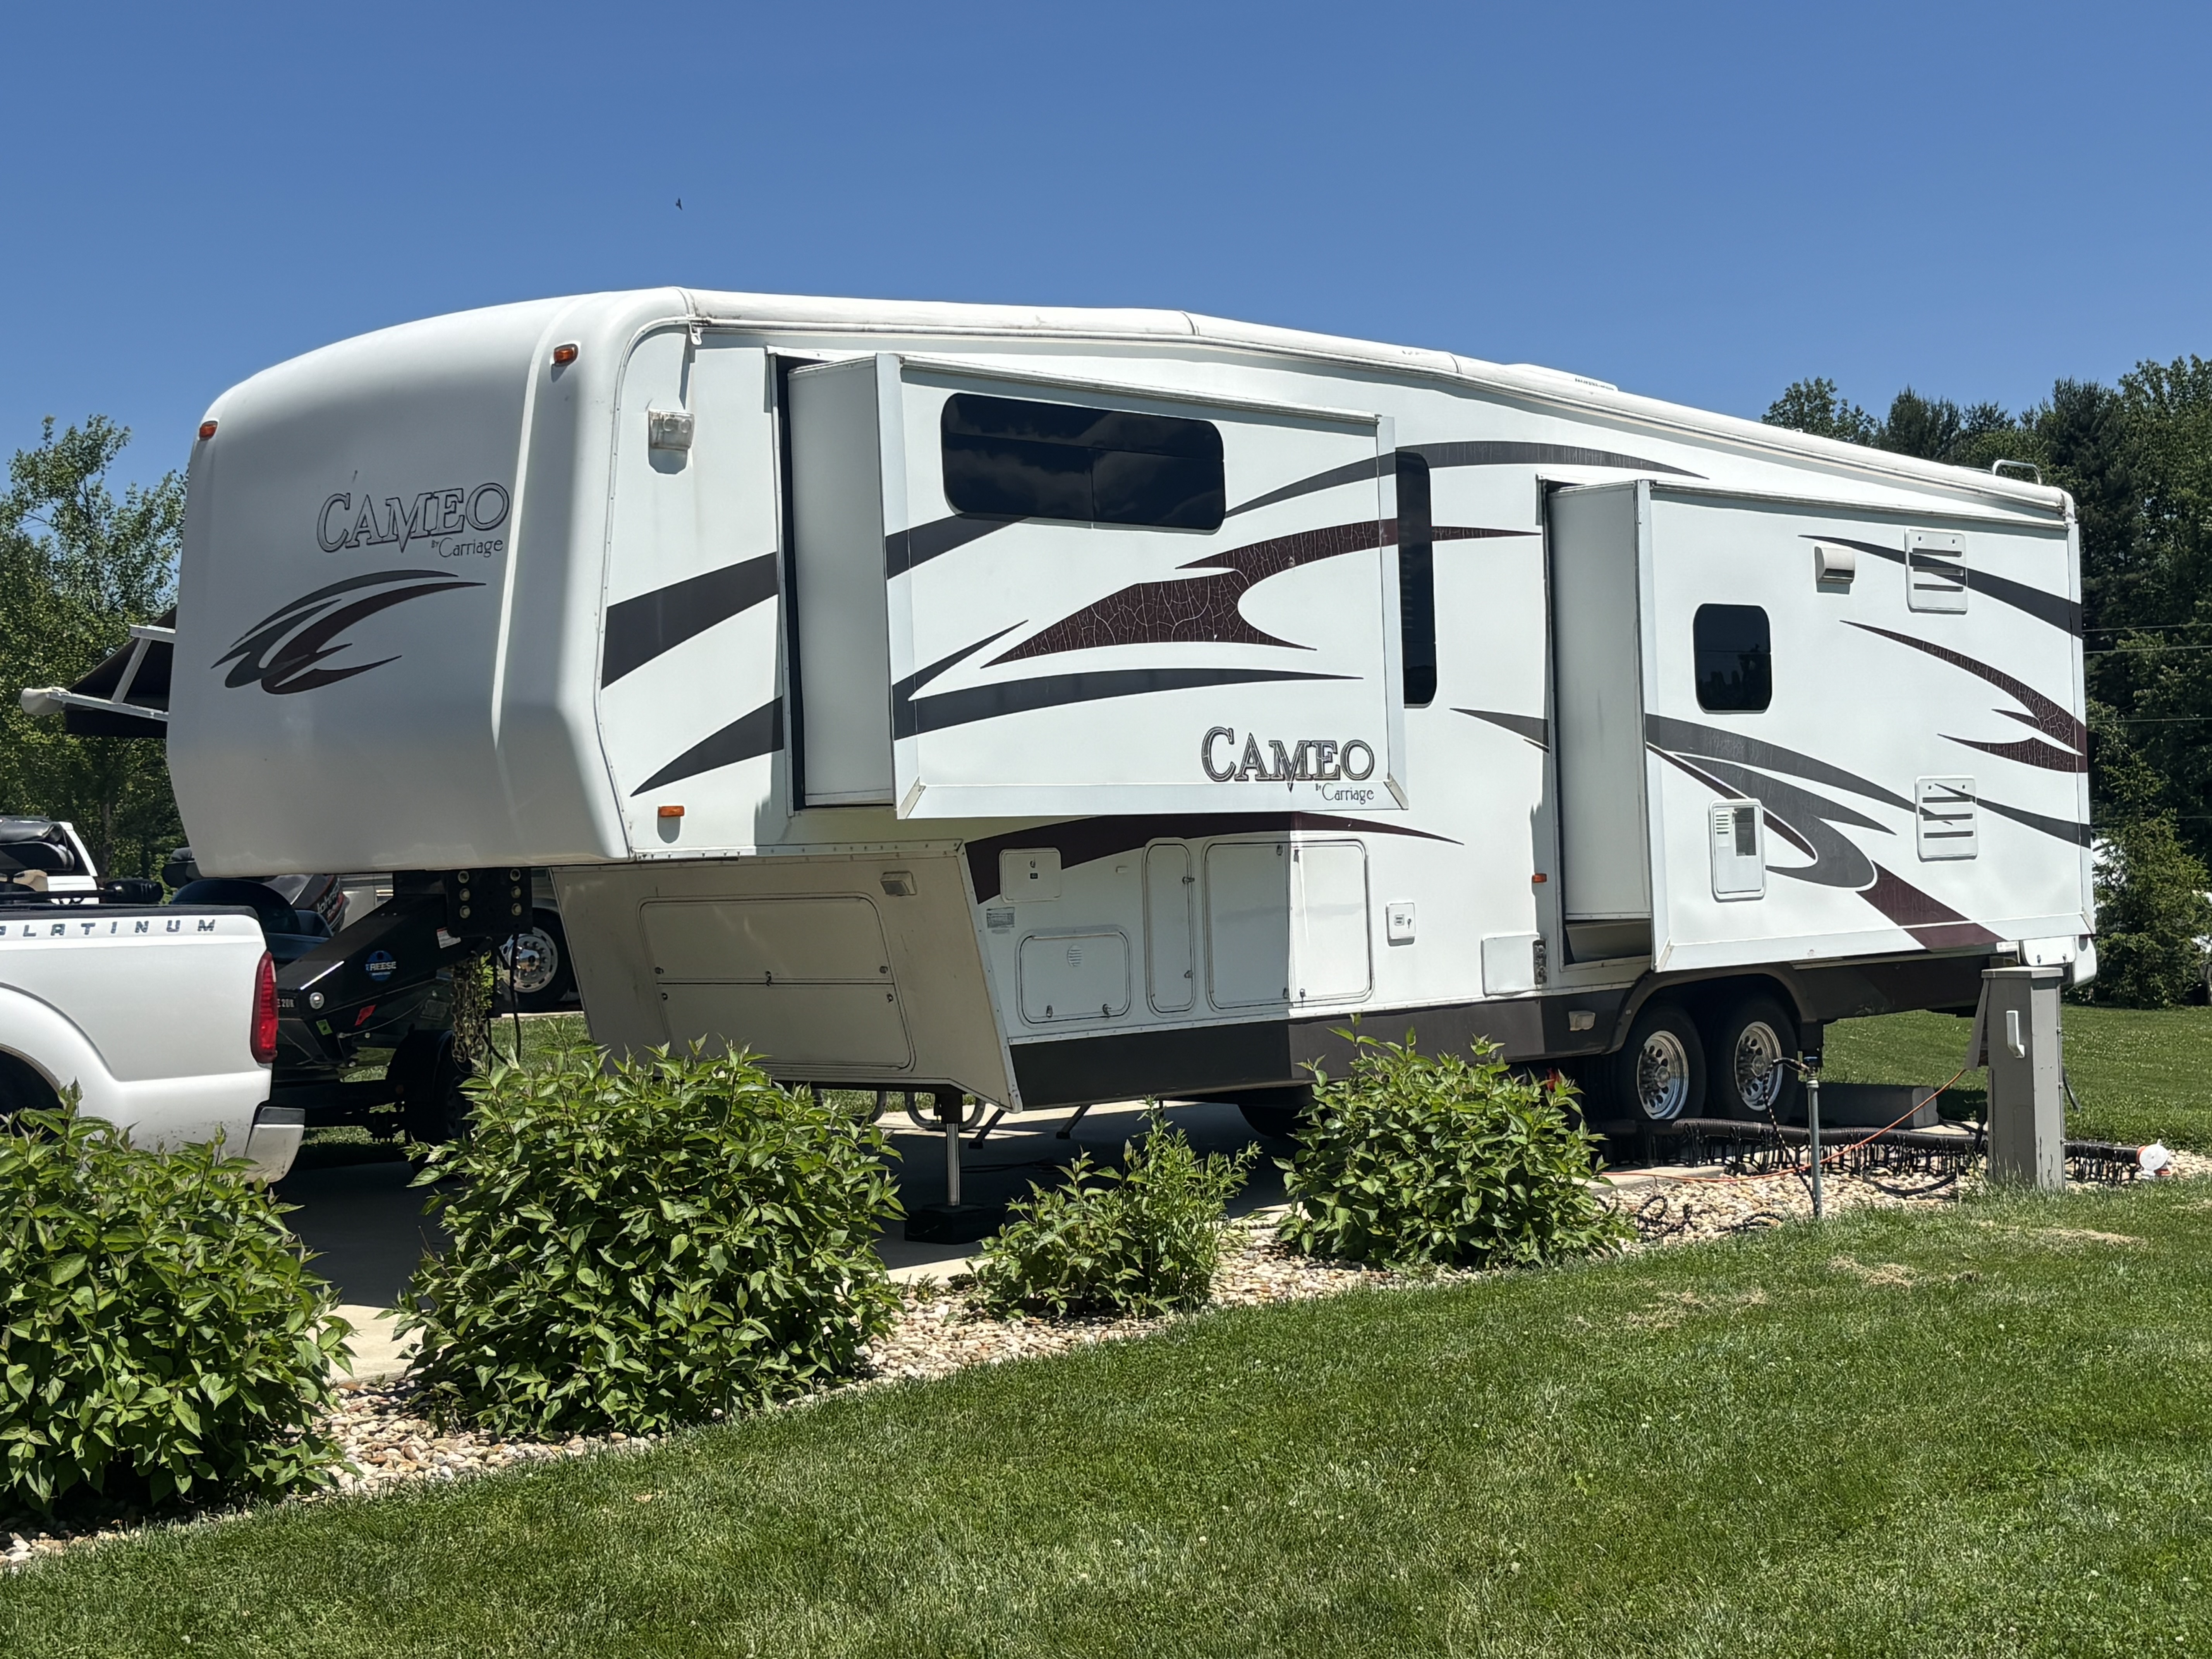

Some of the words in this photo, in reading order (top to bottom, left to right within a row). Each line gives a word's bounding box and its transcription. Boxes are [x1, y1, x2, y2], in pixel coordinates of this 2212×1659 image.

[317, 483, 510, 553] CAMEO
[439, 537, 503, 558] Carriage
[1201, 726, 1374, 793] CAMEO
[1322, 783, 1374, 805] Carriage
[370, 961, 397, 971] REESE
